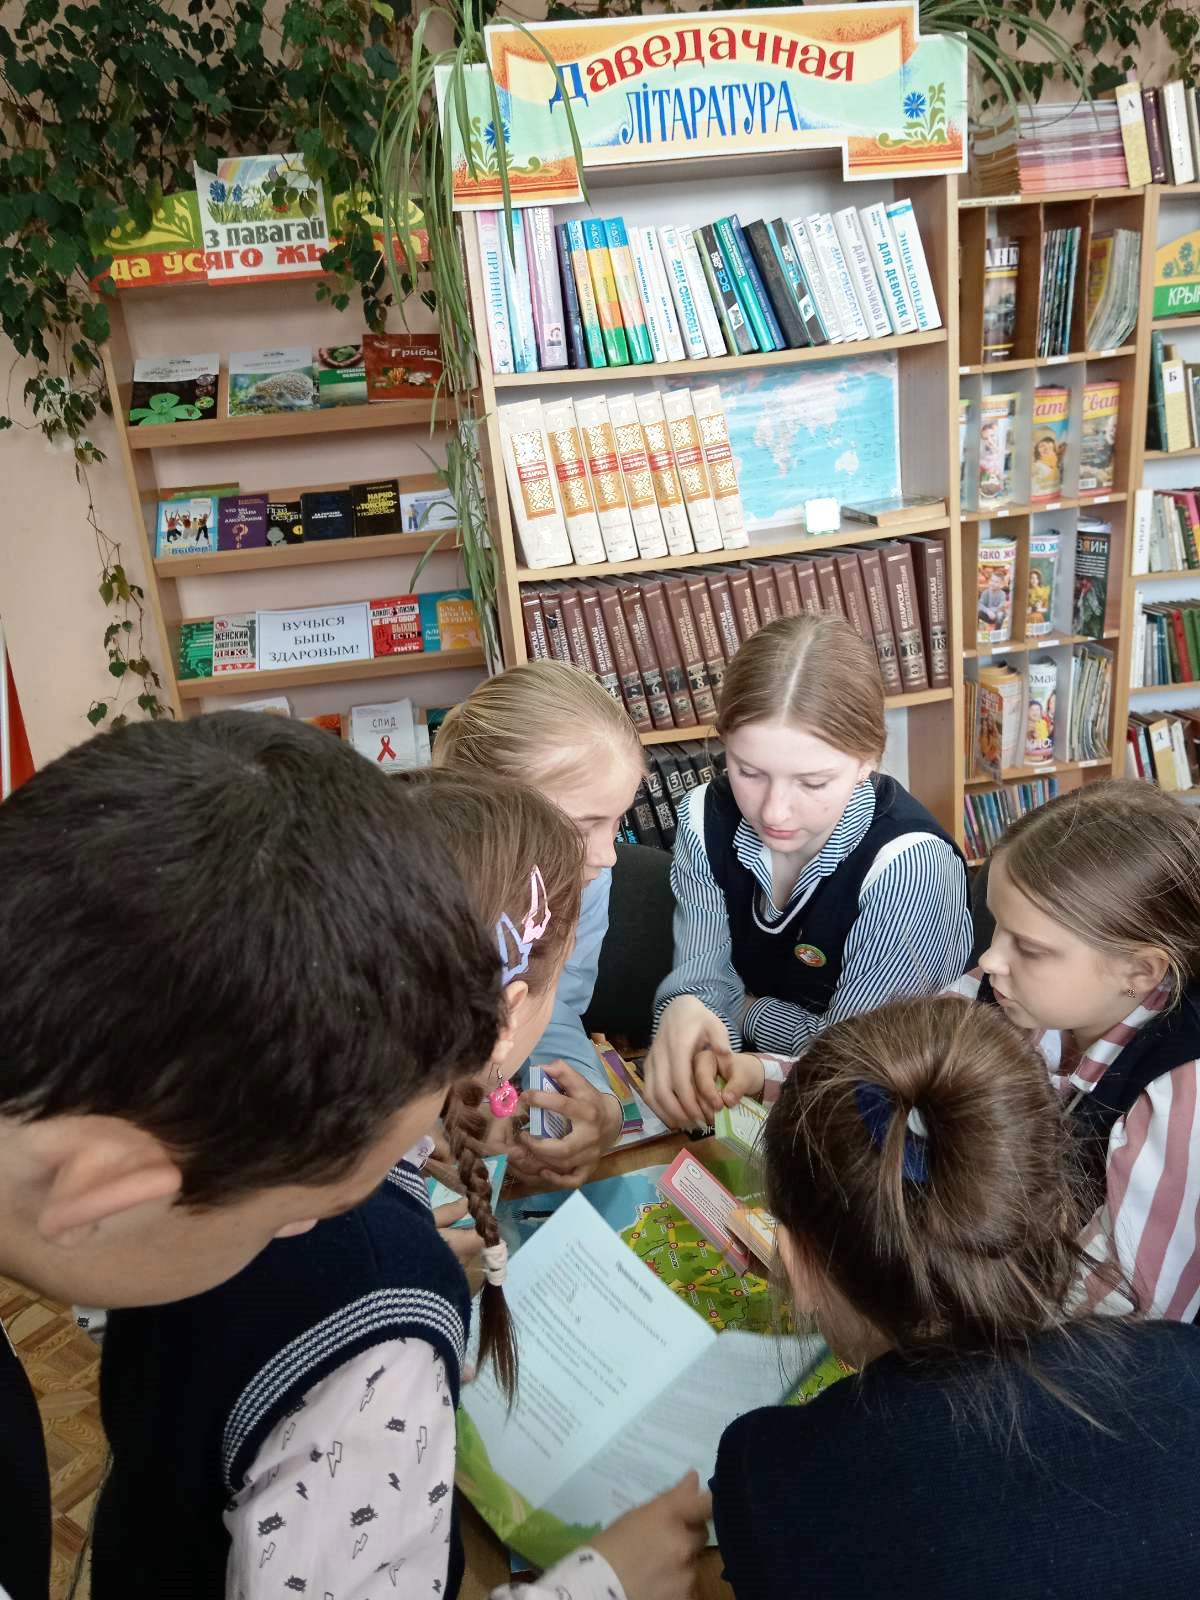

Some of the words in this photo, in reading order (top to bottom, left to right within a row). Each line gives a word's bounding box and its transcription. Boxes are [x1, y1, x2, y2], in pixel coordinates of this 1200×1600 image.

[205, 230, 220, 248] З
[877, 242, 894, 265] ДЛЯ
[899, 230, 929, 328] ЭНЦИКЛОПЕДИЯ
[885, 268, 908, 318] ДЕВОЧЕК
[282, 616, 345, 631] ВУЧЫСЯ
[294, 633, 335, 645] БЫЦЬ
[269, 644, 360, 663] ЗДАРОВЫМ!
[372, 718, 398, 729] СПИД
